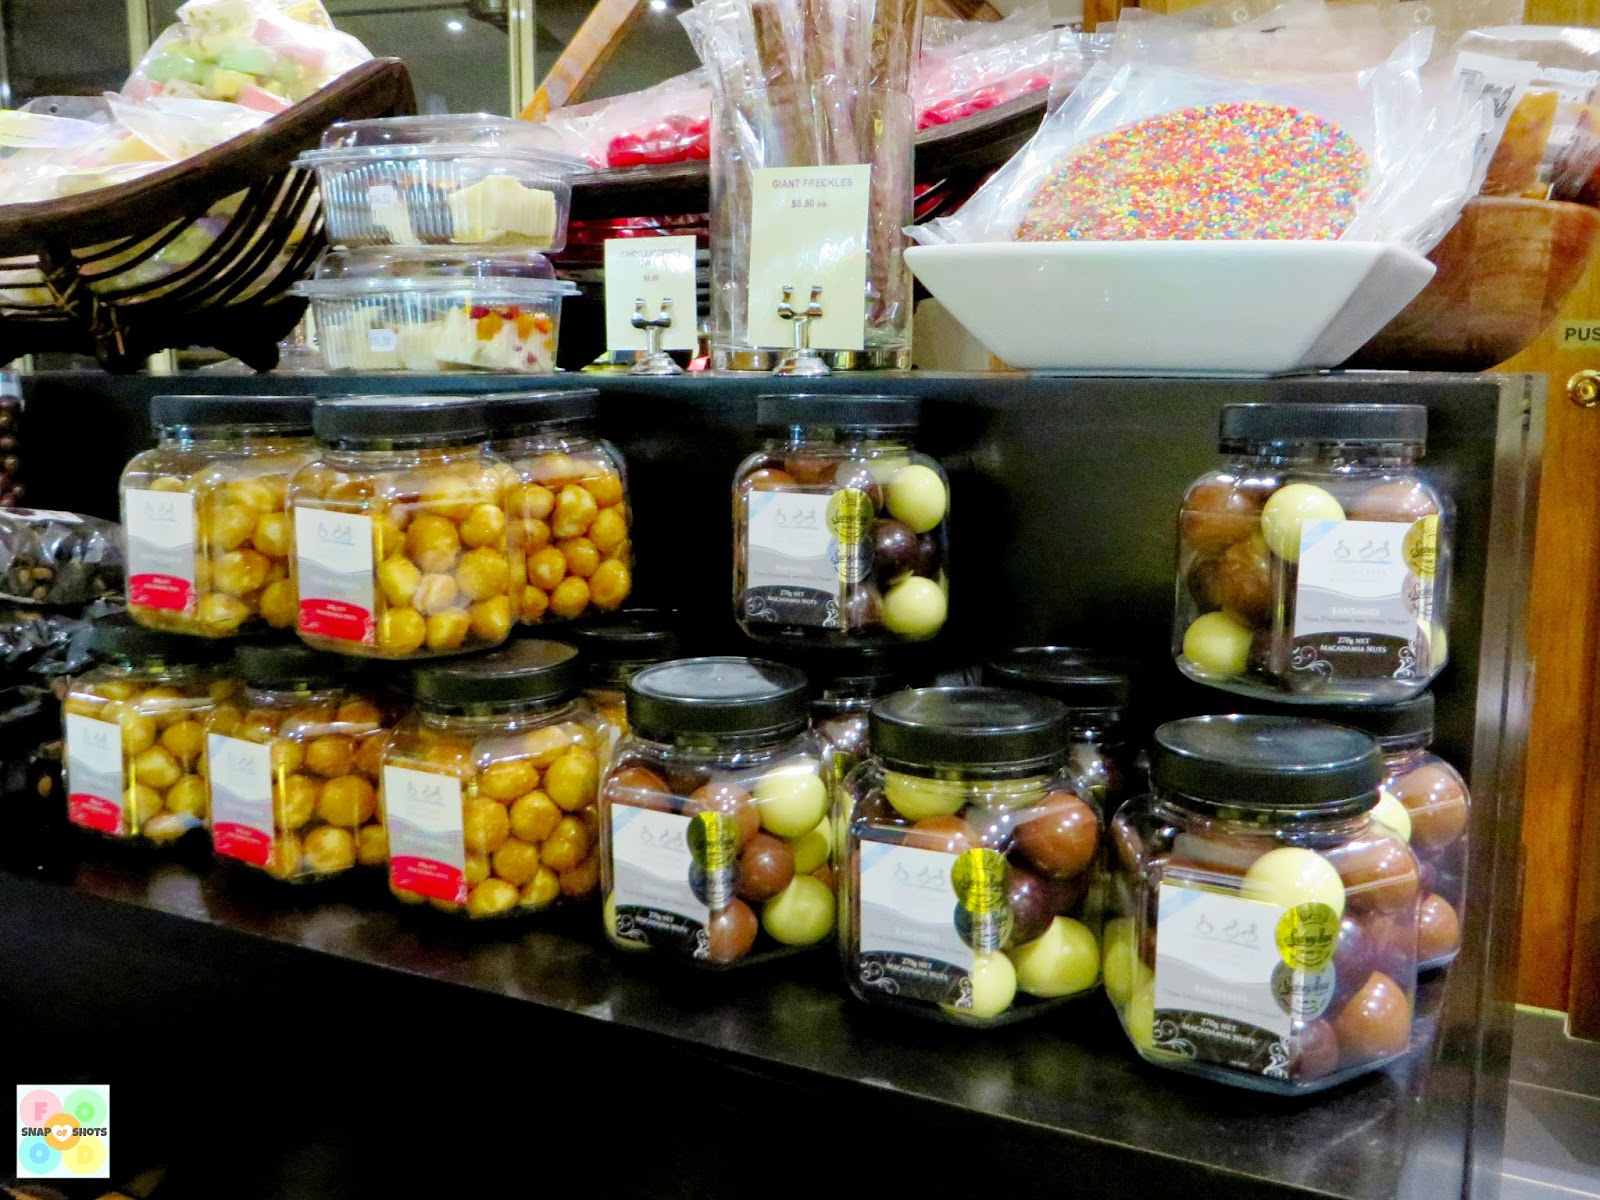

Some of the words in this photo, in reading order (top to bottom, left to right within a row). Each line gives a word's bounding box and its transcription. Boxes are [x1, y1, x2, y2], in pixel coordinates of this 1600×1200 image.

[772, 179, 801, 188] GIANT
[803, 177, 853, 188] FRECKLES
[1337, 636, 1354, 644] 270g
[1320, 644, 1364, 652] MACADAMIA
